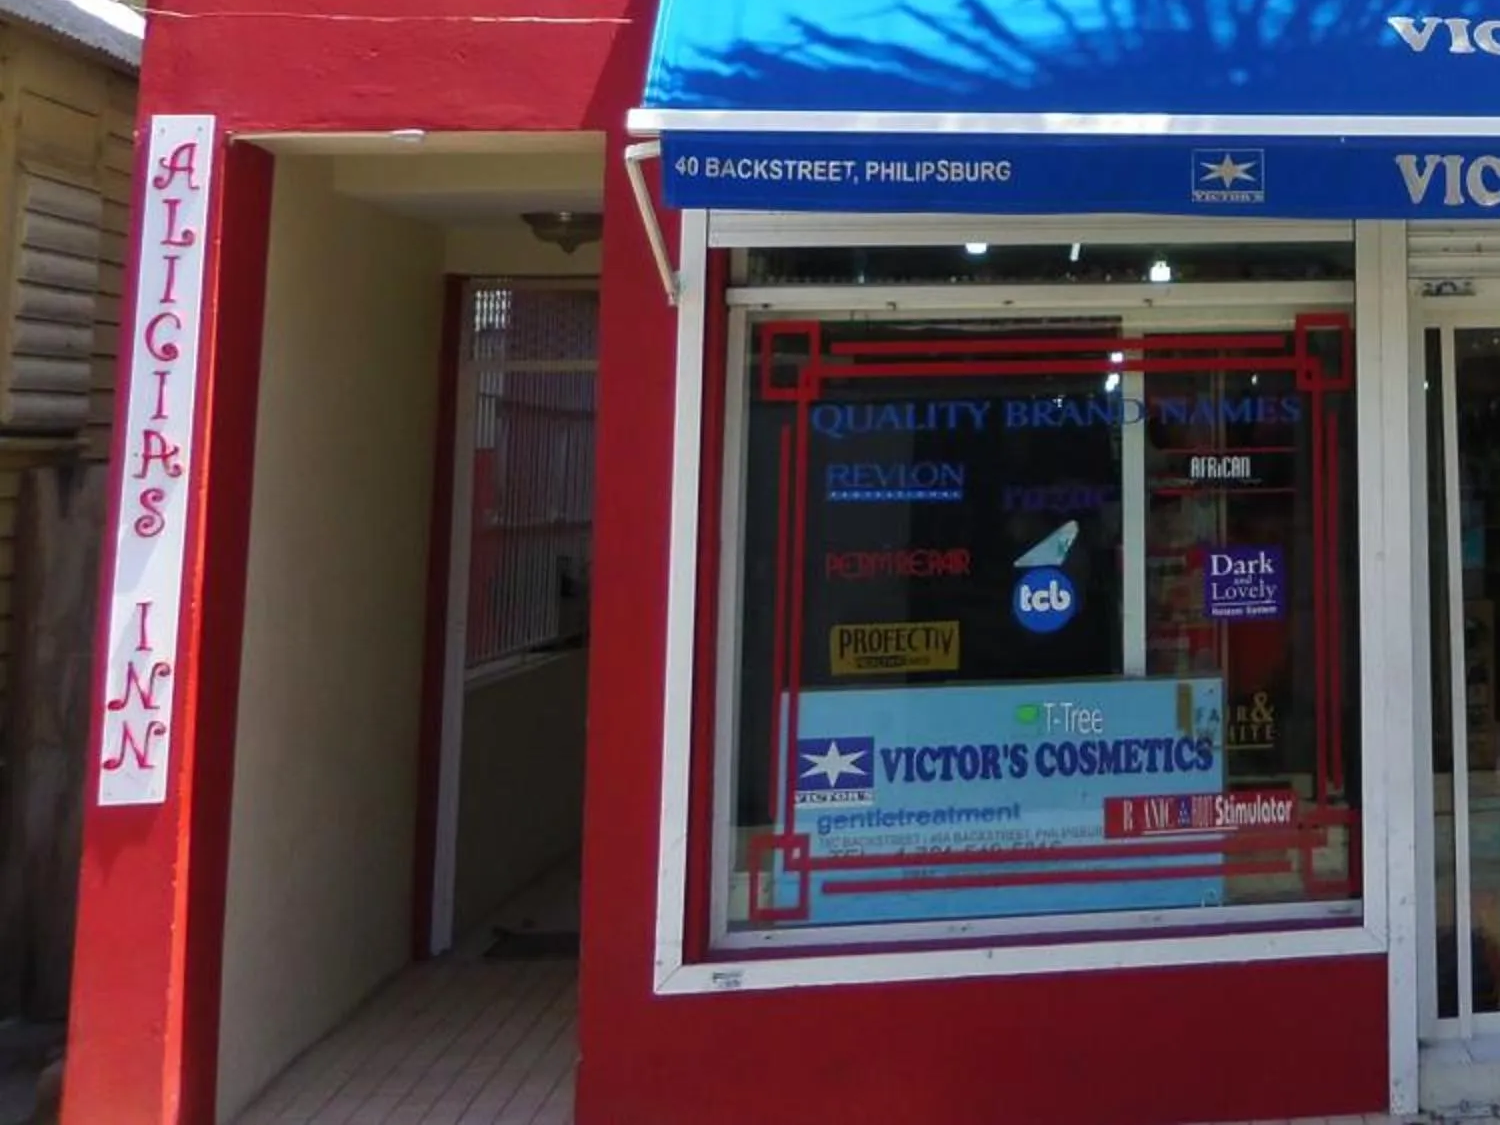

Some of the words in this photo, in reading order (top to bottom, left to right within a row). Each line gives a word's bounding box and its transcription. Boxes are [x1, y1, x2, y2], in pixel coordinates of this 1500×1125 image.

[674, 155, 699, 177] 40
[706, 157, 860, 185] BACKSTREET,
[865, 159, 1012, 183] PHILIPSBURG
[811, 401, 991, 438] QUALITY
[1006, 397, 1148, 427] BRAND
[1158, 396, 1301, 424] NAMES
[1211, 551, 1274, 577] Dark
[1020, 580, 1071, 613] tcb
[1211, 578, 1277, 601] Lovely
[839, 626, 954, 659] PROFECTIV
[1044, 702, 1104, 734] T-Tree
[879, 742, 1029, 784] VICTOR'S
[1035, 735, 1214, 778] COSMETICS
[1215, 793, 1293, 826] Stimulator
